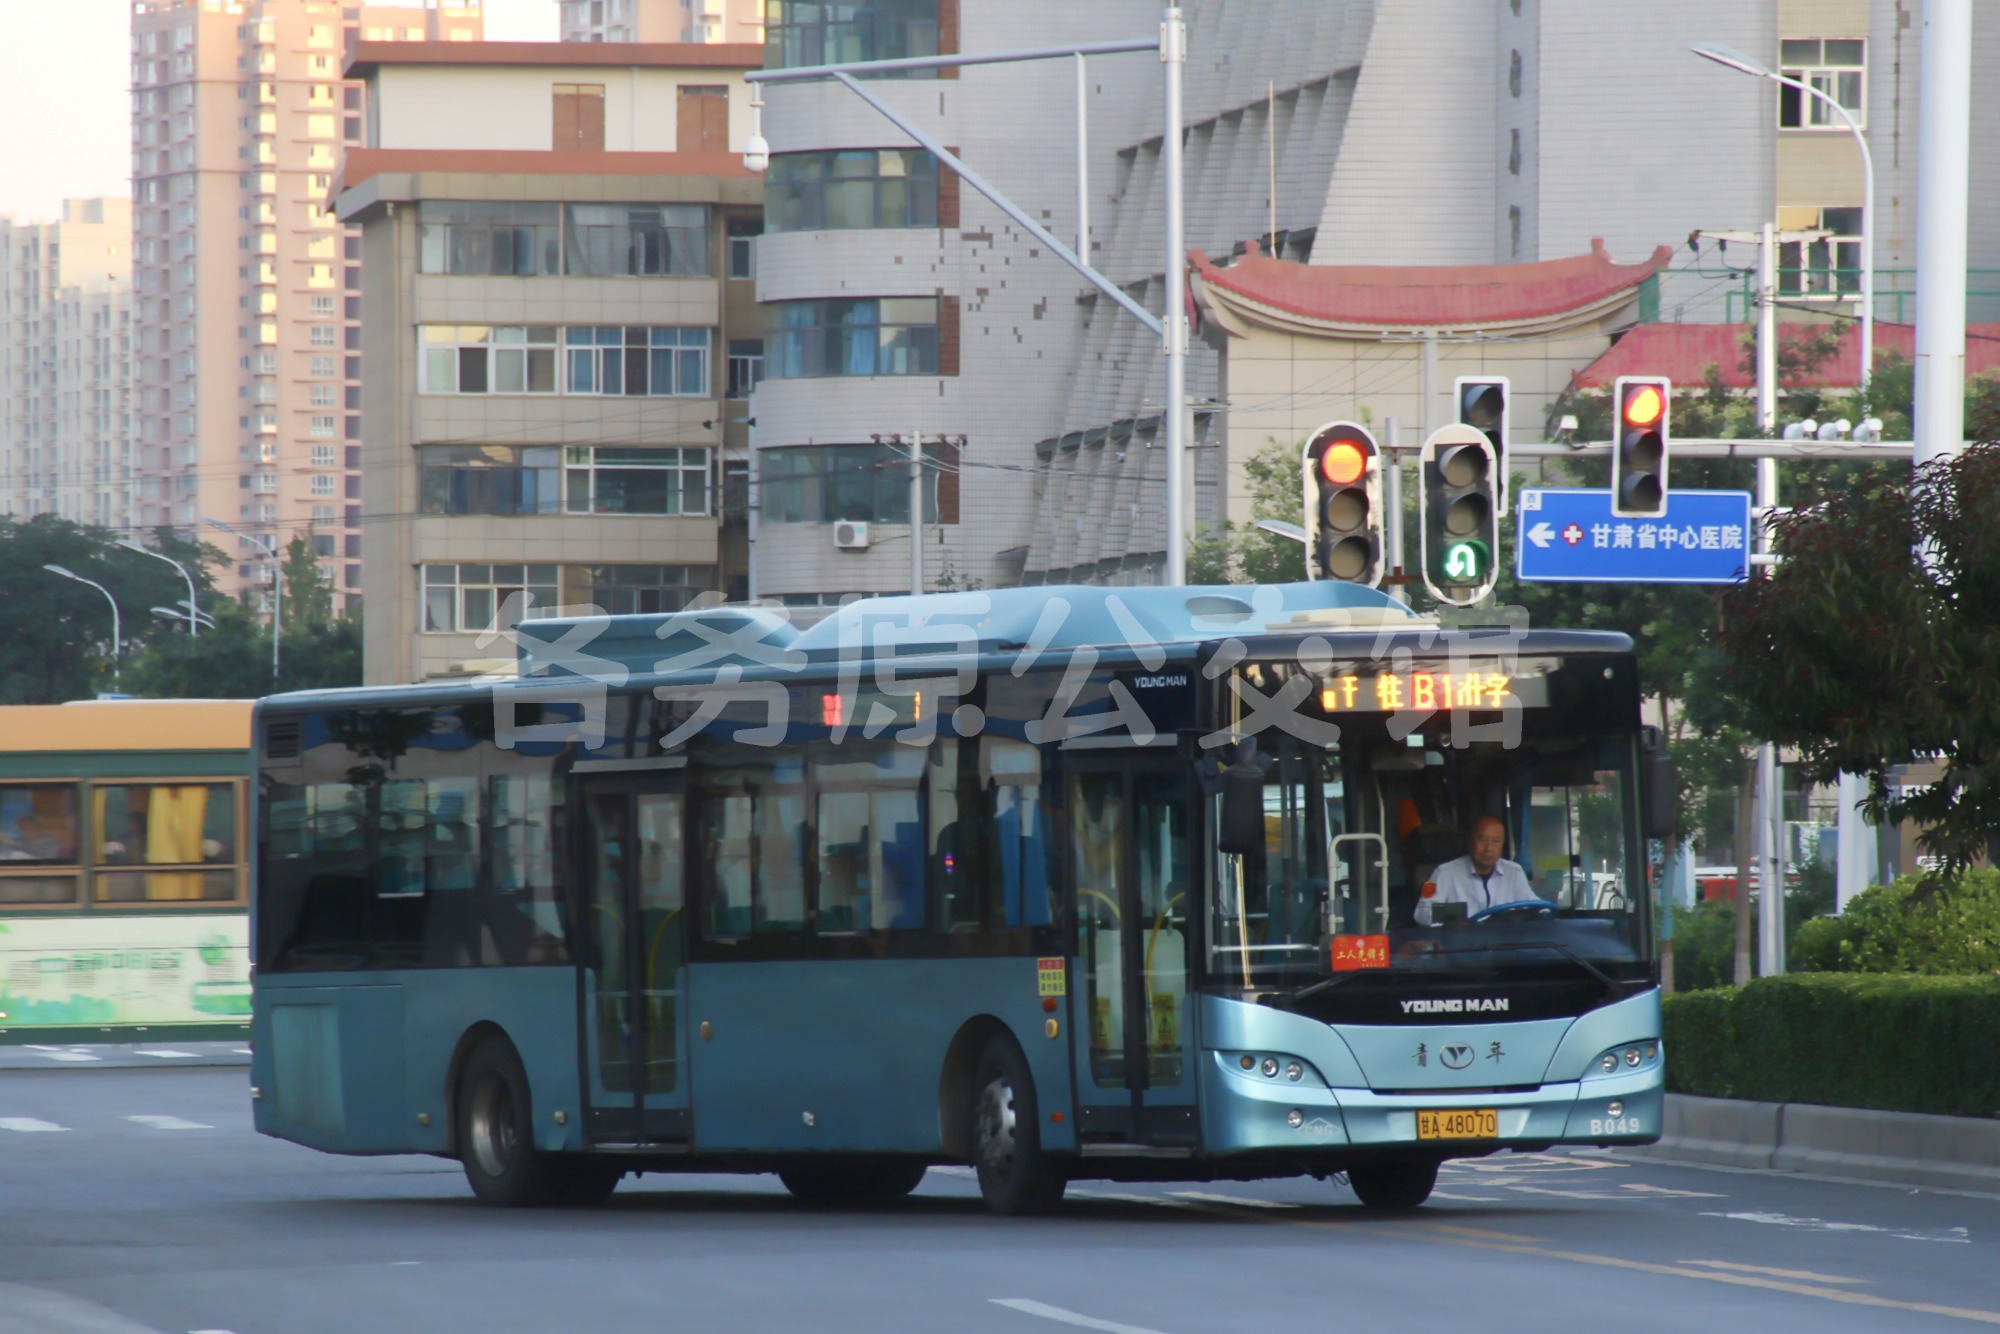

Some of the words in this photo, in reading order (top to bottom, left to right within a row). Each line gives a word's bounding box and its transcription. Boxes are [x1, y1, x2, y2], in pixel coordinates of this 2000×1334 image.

[1590, 523, 1743, 550] 甘肃省中心医院
[1166, 675, 1187, 687] MAN
[1400, 999, 1464, 1014] YOUNG
[1465, 998, 1510, 1012] MAN
[1304, 1124, 1334, 1137] CNG
[1589, 1117, 1641, 1136] B049
